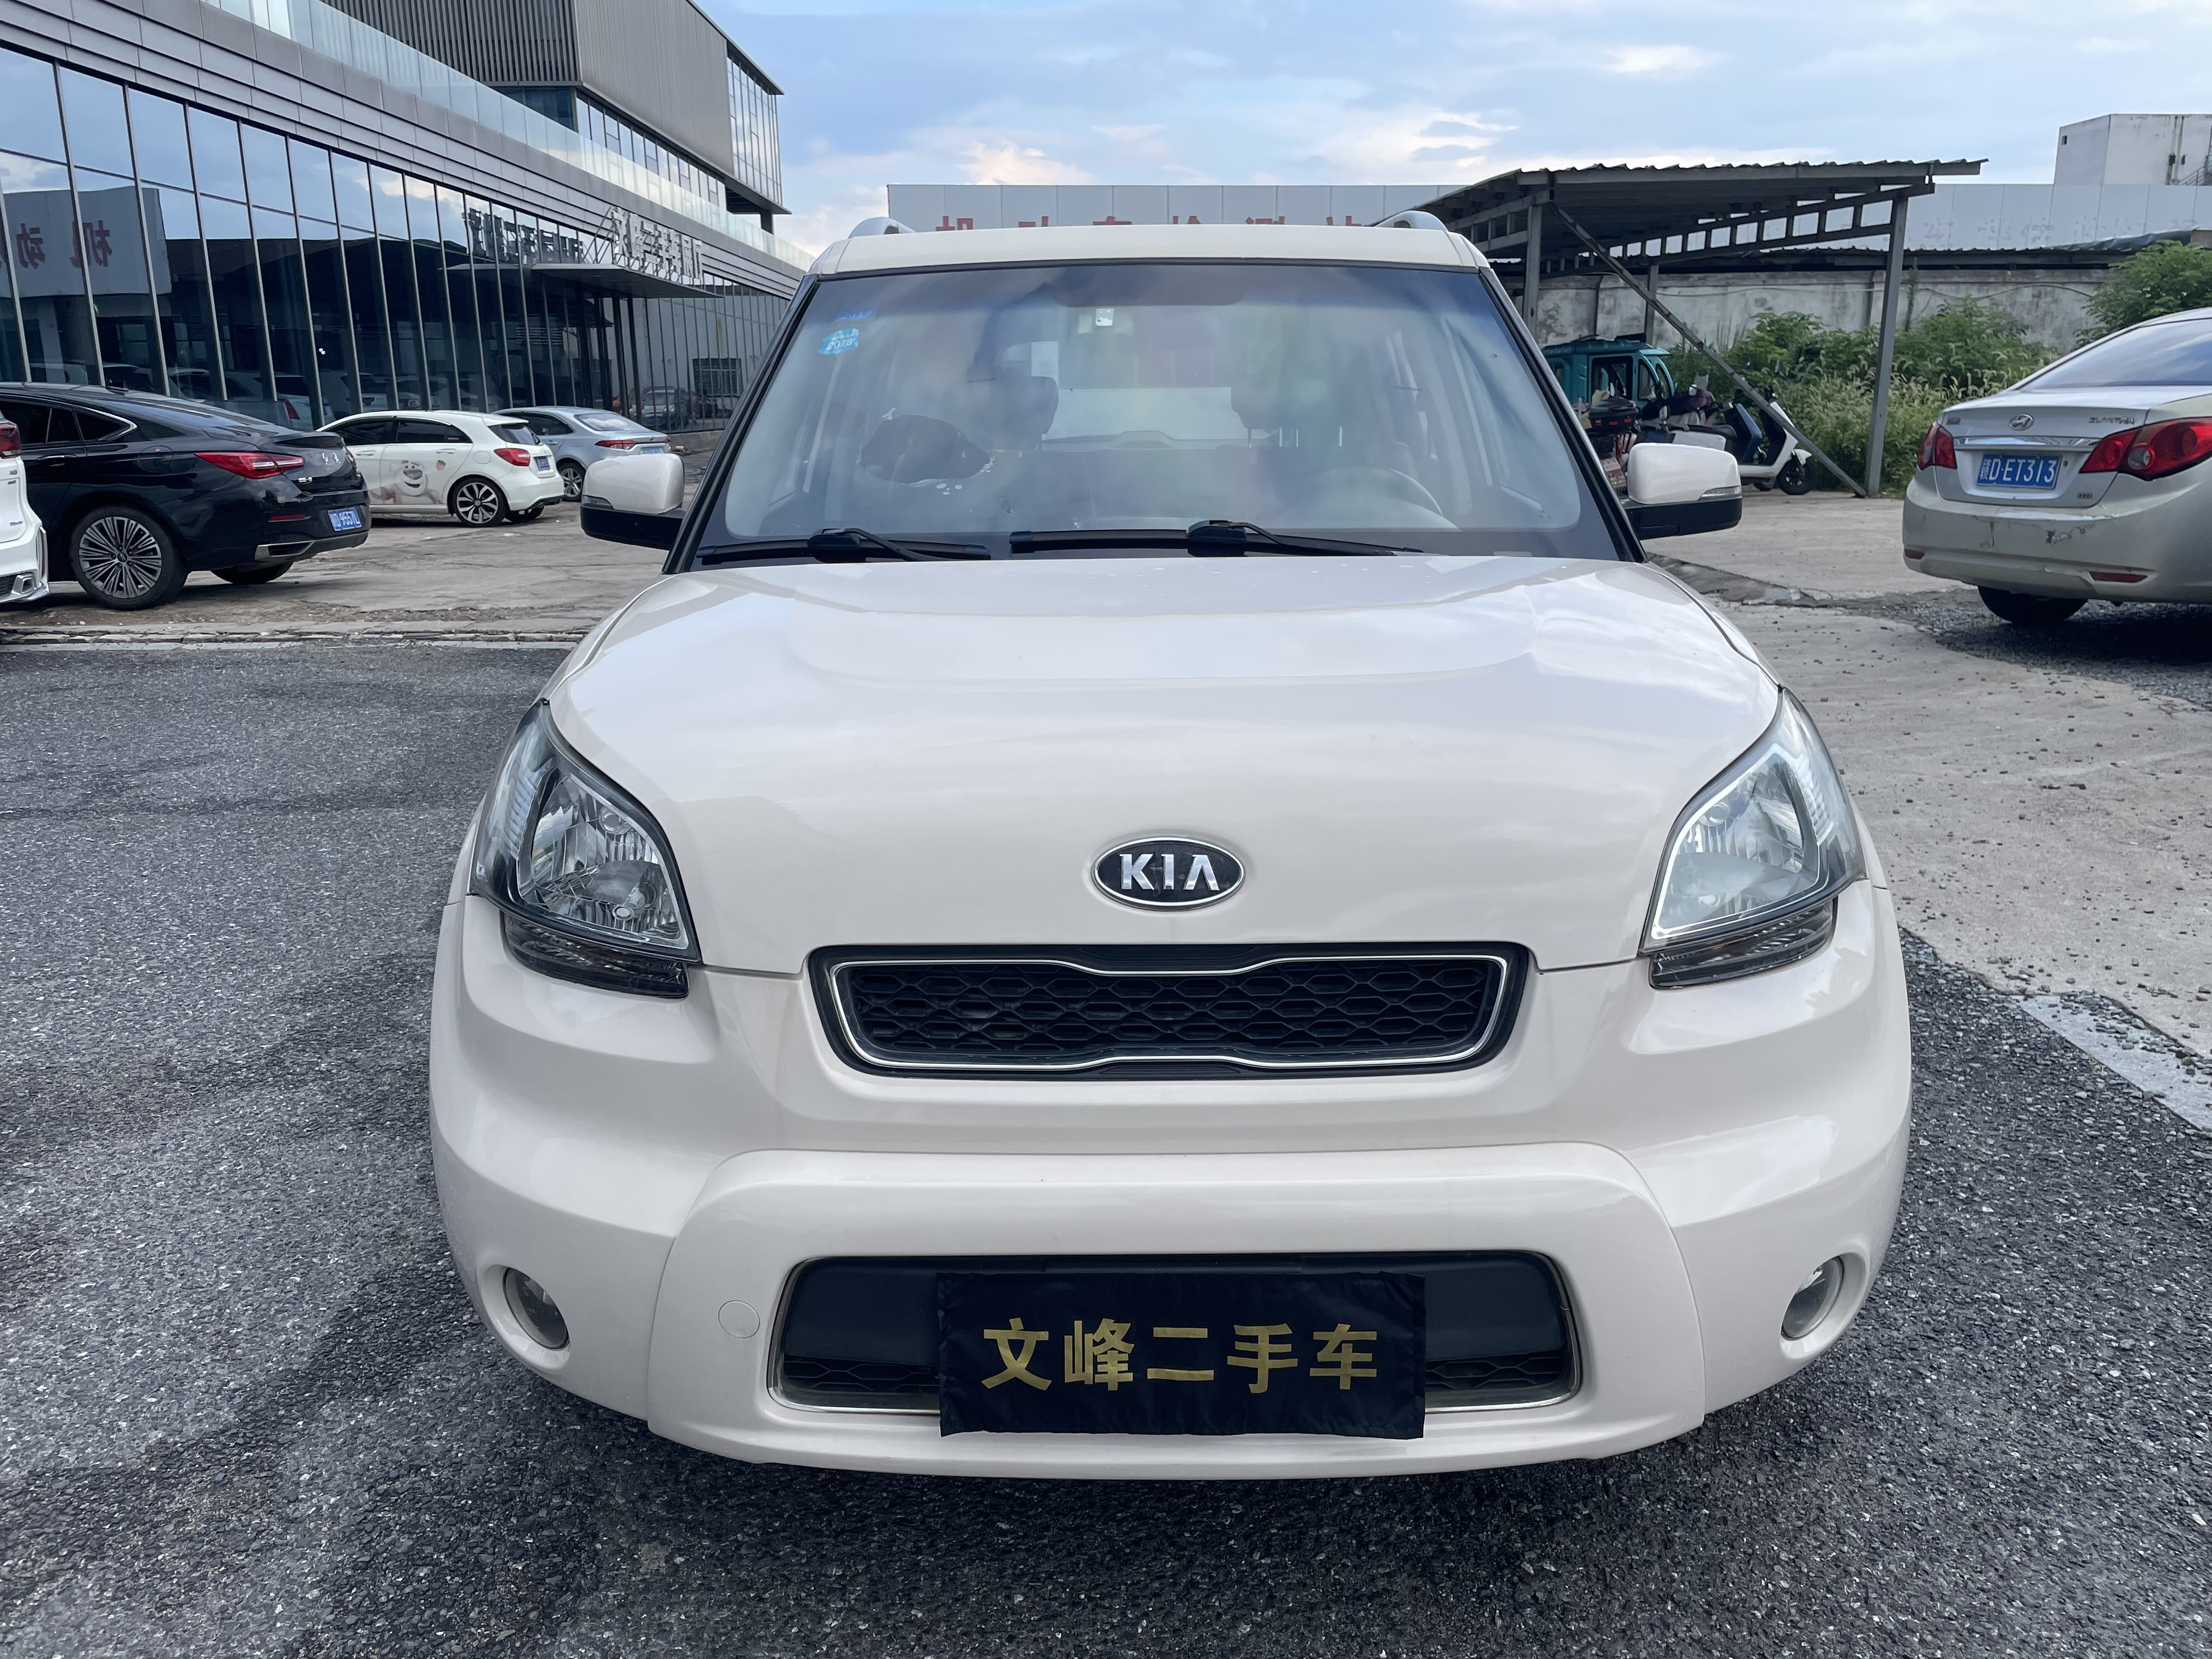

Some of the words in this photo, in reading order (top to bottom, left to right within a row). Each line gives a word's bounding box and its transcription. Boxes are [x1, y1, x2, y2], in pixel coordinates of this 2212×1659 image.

[826, 338, 853, 351] 2018
[1119, 854, 1220, 891] KIA
[981, 1317, 1378, 1393] 文峰二手车
